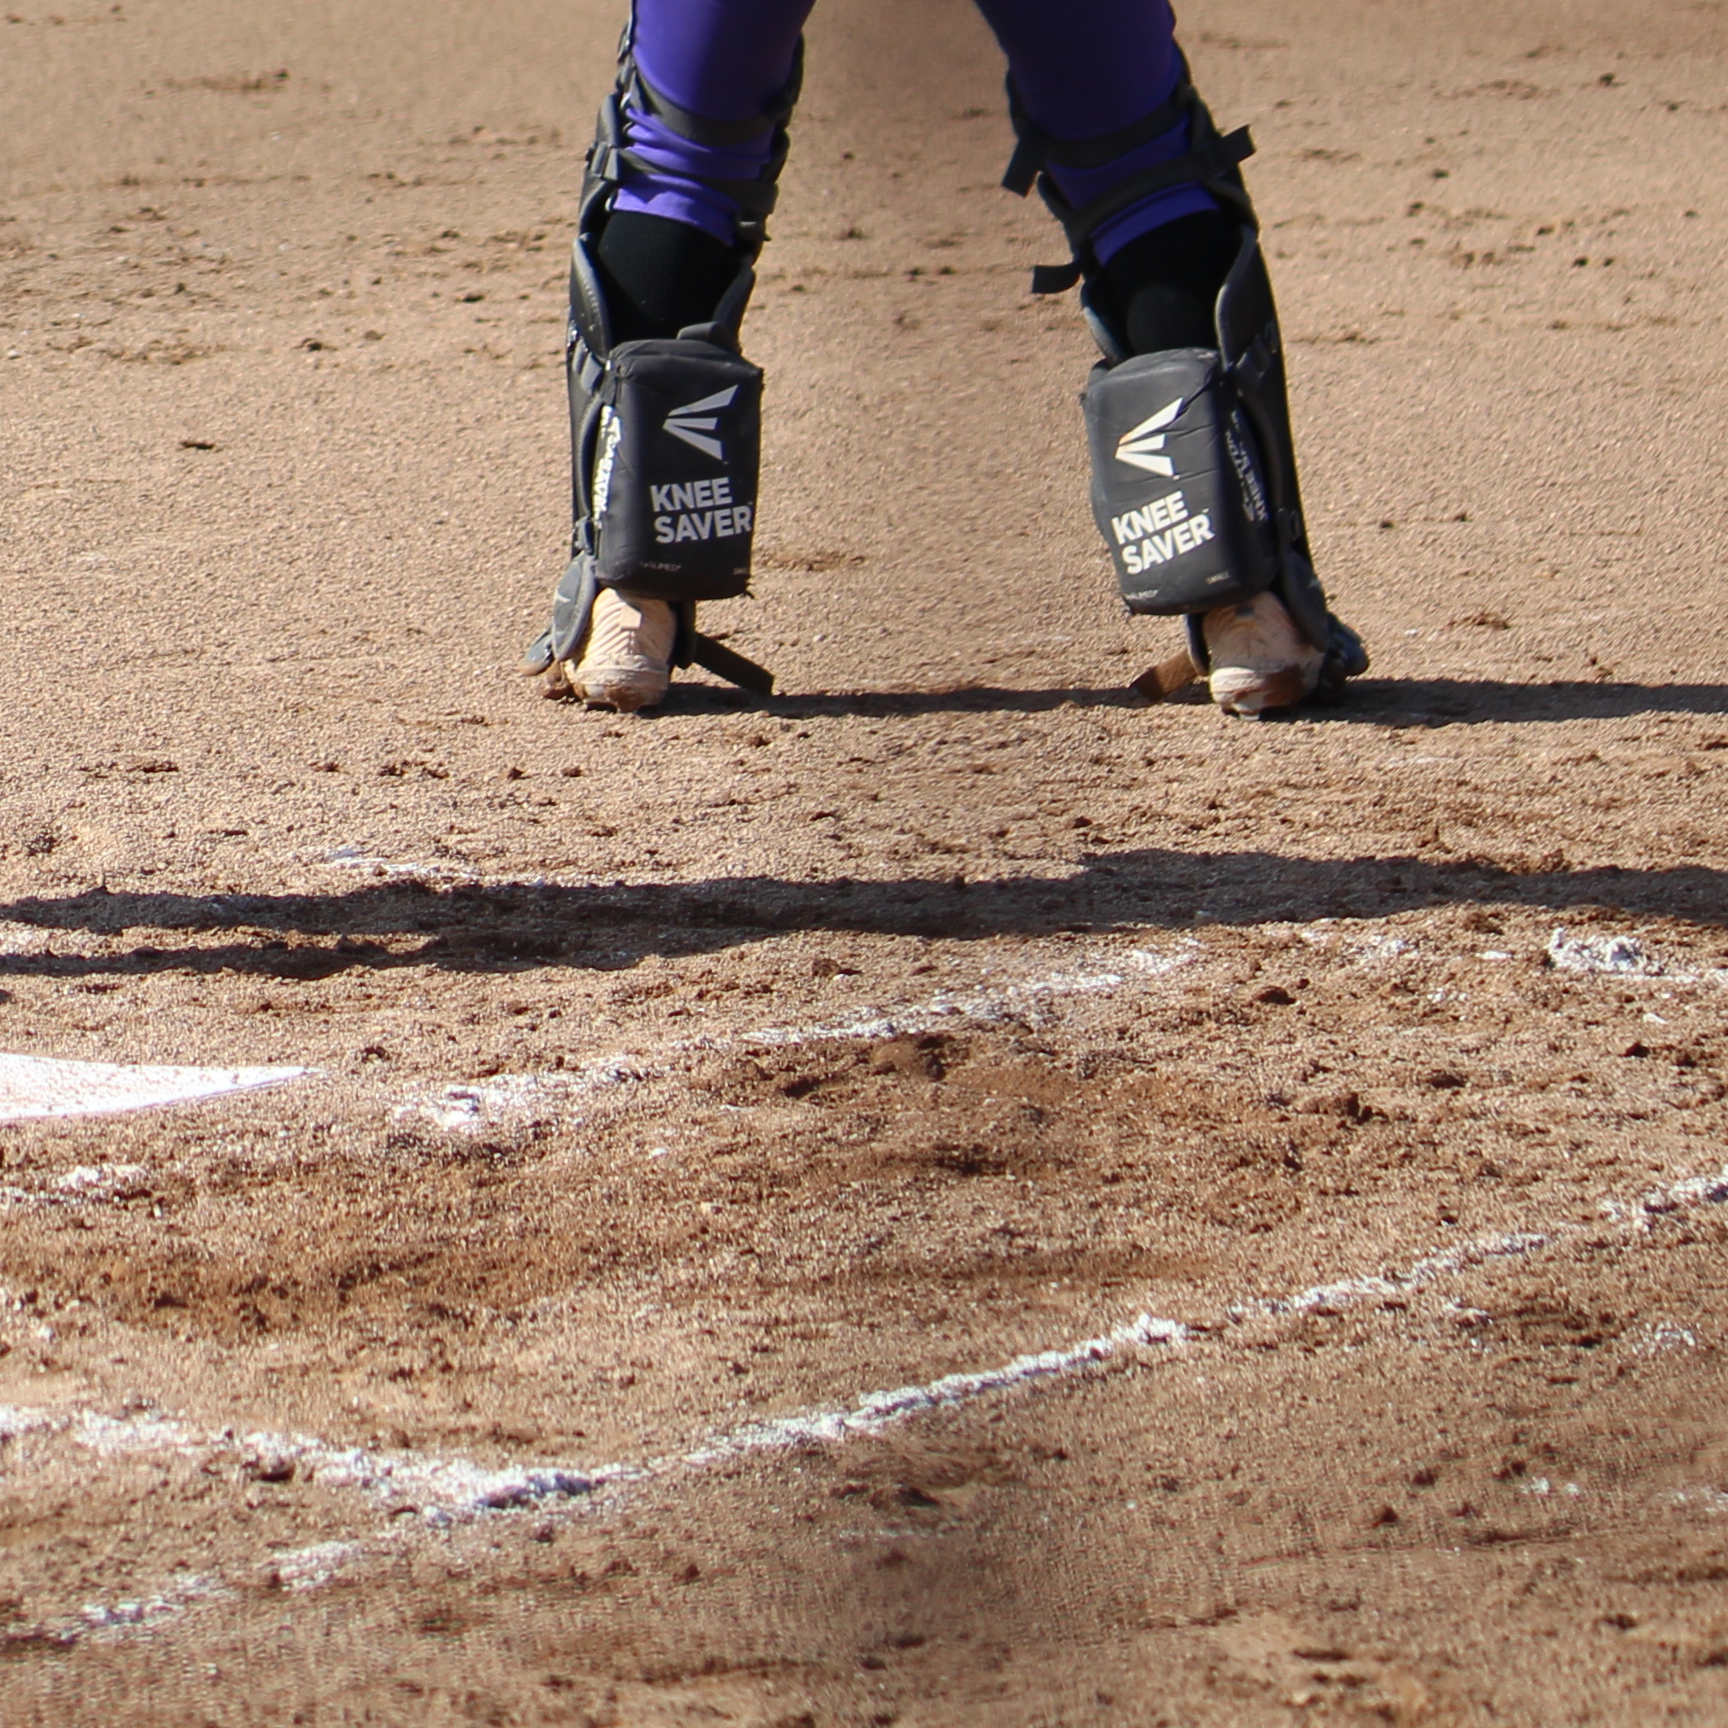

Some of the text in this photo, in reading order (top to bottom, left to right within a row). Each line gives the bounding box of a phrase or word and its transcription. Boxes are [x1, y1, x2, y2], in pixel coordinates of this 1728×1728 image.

[650, 476, 733, 512] KNEE
[1111, 490, 1189, 545] KNEE
[653, 505, 753, 544] SAVER
[1121, 514, 1215, 575] SAVER
